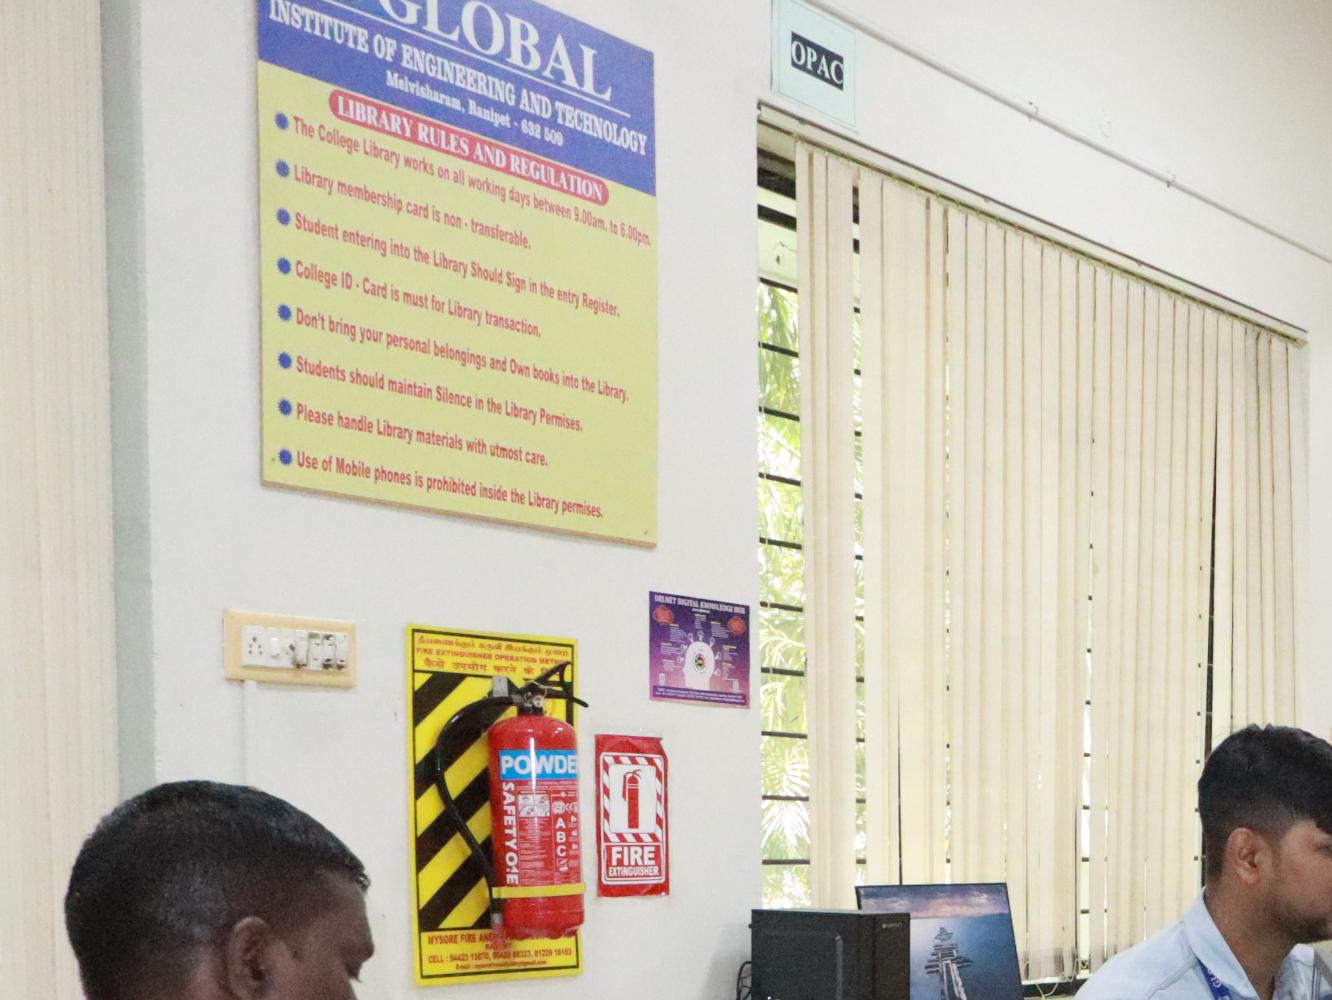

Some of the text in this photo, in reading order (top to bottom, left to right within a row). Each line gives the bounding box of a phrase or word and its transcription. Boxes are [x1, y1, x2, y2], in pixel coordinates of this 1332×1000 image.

[269, 0, 648, 155] INSTITUTE OF ENGINEERING AND TECHNOLOGY
[791, 40, 844, 84] OPAC
[338, 95, 603, 202] LIBRARY RULES AND REGULATION
[468, 99, 511, 128] Ranipet
[521, 119, 541, 140] 632
[544, 125, 564, 146] 509
[293, 115, 315, 139] The
[318, 128, 360, 155] College
[363, 138, 400, 169] Library
[403, 155, 434, 177] works
[437, 166, 450, 181] on
[452, 169, 465, 186] all
[467, 174, 506, 203] working
[508, 186, 531, 208] days
[533, 193, 571, 220] between
[609, 220, 618, 235] to
[294, 164, 334, 195] Library
[337, 180, 403, 215] membership
[406, 201, 429, 219] card
[432, 209, 440, 223] is
[443, 212, 462, 228] non
[295, 211, 339, 240] Student
[342, 229, 387, 257] entering
[390, 242, 410, 259] into
[413, 245, 430, 264] the
[433, 250, 468, 279] Library
[470, 260, 503, 284] Should
[505, 270, 526, 293] Sign
[529, 282, 537, 294] in
[539, 281, 555, 299] the
[556, 289, 579, 310] entry
[295, 259, 337, 289] College
[341, 271, 352, 290] ID
[362, 276, 387, 299] Card
[390, 288, 400, 302] is
[402, 291, 428, 309] must
[431, 294, 445, 313] for
[448, 299, 482, 327] Library
[328, 315, 356, 342] bring
[359, 327, 383, 344] your
[385, 332, 430, 354] personal
[433, 340, 487, 370] belongings
[489, 357, 507, 372] and
[509, 357, 530, 377] Own
[532, 364, 560, 384] books
[562, 374, 579, 389] into
[581, 376, 595, 393] the
[296, 355, 346, 382] Students
[349, 367, 385, 390] should
[387, 378, 432, 400] maintain
[435, 385, 472, 408] Silence
[474, 398, 484, 410] in
[486, 397, 502, 414] the
[504, 400, 537, 426] Library
[296, 402, 334, 426] Please
[337, 410, 374, 434] handle
[376, 418, 413, 445] Library
[416, 430, 463, 451] materials
[465, 438, 487, 455] with
[489, 443, 523, 462] utmost
[296, 450, 318, 470] Use
[321, 455, 333, 472] of
[335, 456, 371, 479] Mobile
[374, 465, 412, 486] phones
[414, 471, 424, 488] is
[426, 476, 477, 497] prohibited
[479, 482, 508, 502] inside
[510, 488, 525, 505] the
[527, 490, 560, 514] Library
[494, 653, 537, 664] OPERATION
[609, 866, 660, 877] EXTINGUISHER
[611, 846, 656, 866] FIRE
[428, 955, 444, 964] CELL
[460, 934, 477, 943] FIRE
